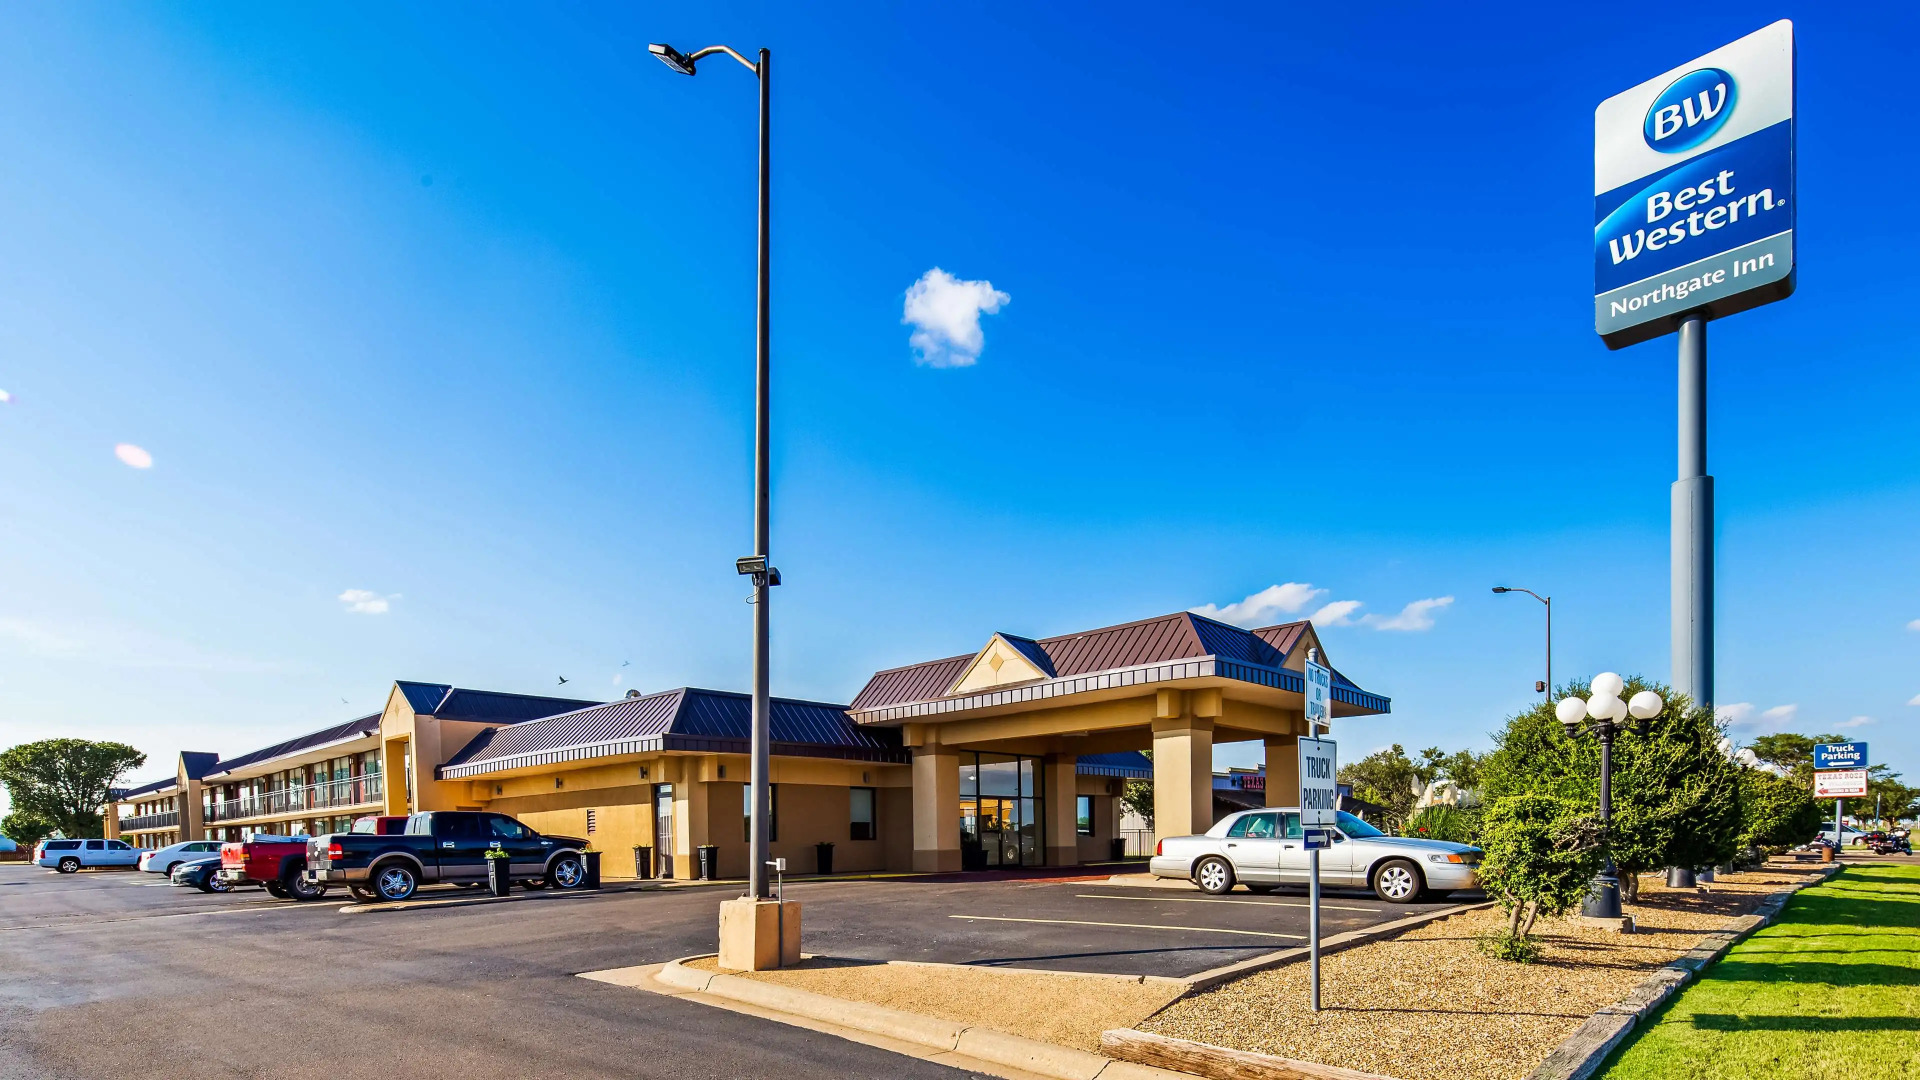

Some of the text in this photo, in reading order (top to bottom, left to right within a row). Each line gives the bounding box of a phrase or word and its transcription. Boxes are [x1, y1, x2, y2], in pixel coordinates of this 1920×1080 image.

[1654, 83, 1727, 142] BW
[1647, 169, 1735, 224] Best
[1609, 188, 1775, 265] Western
[1610, 252, 1775, 318] Northgate Inn
[1314, 670, 1328, 689] TRUCKS
[1316, 687, 1322, 702] OR
[1821, 752, 1860, 760] Parking
[1826, 744, 1854, 753] Truck
[1306, 756, 1331, 779] TRUCK
[1242, 775, 1264, 790] TEXAS
[1303, 787, 1334, 810] PARKING
